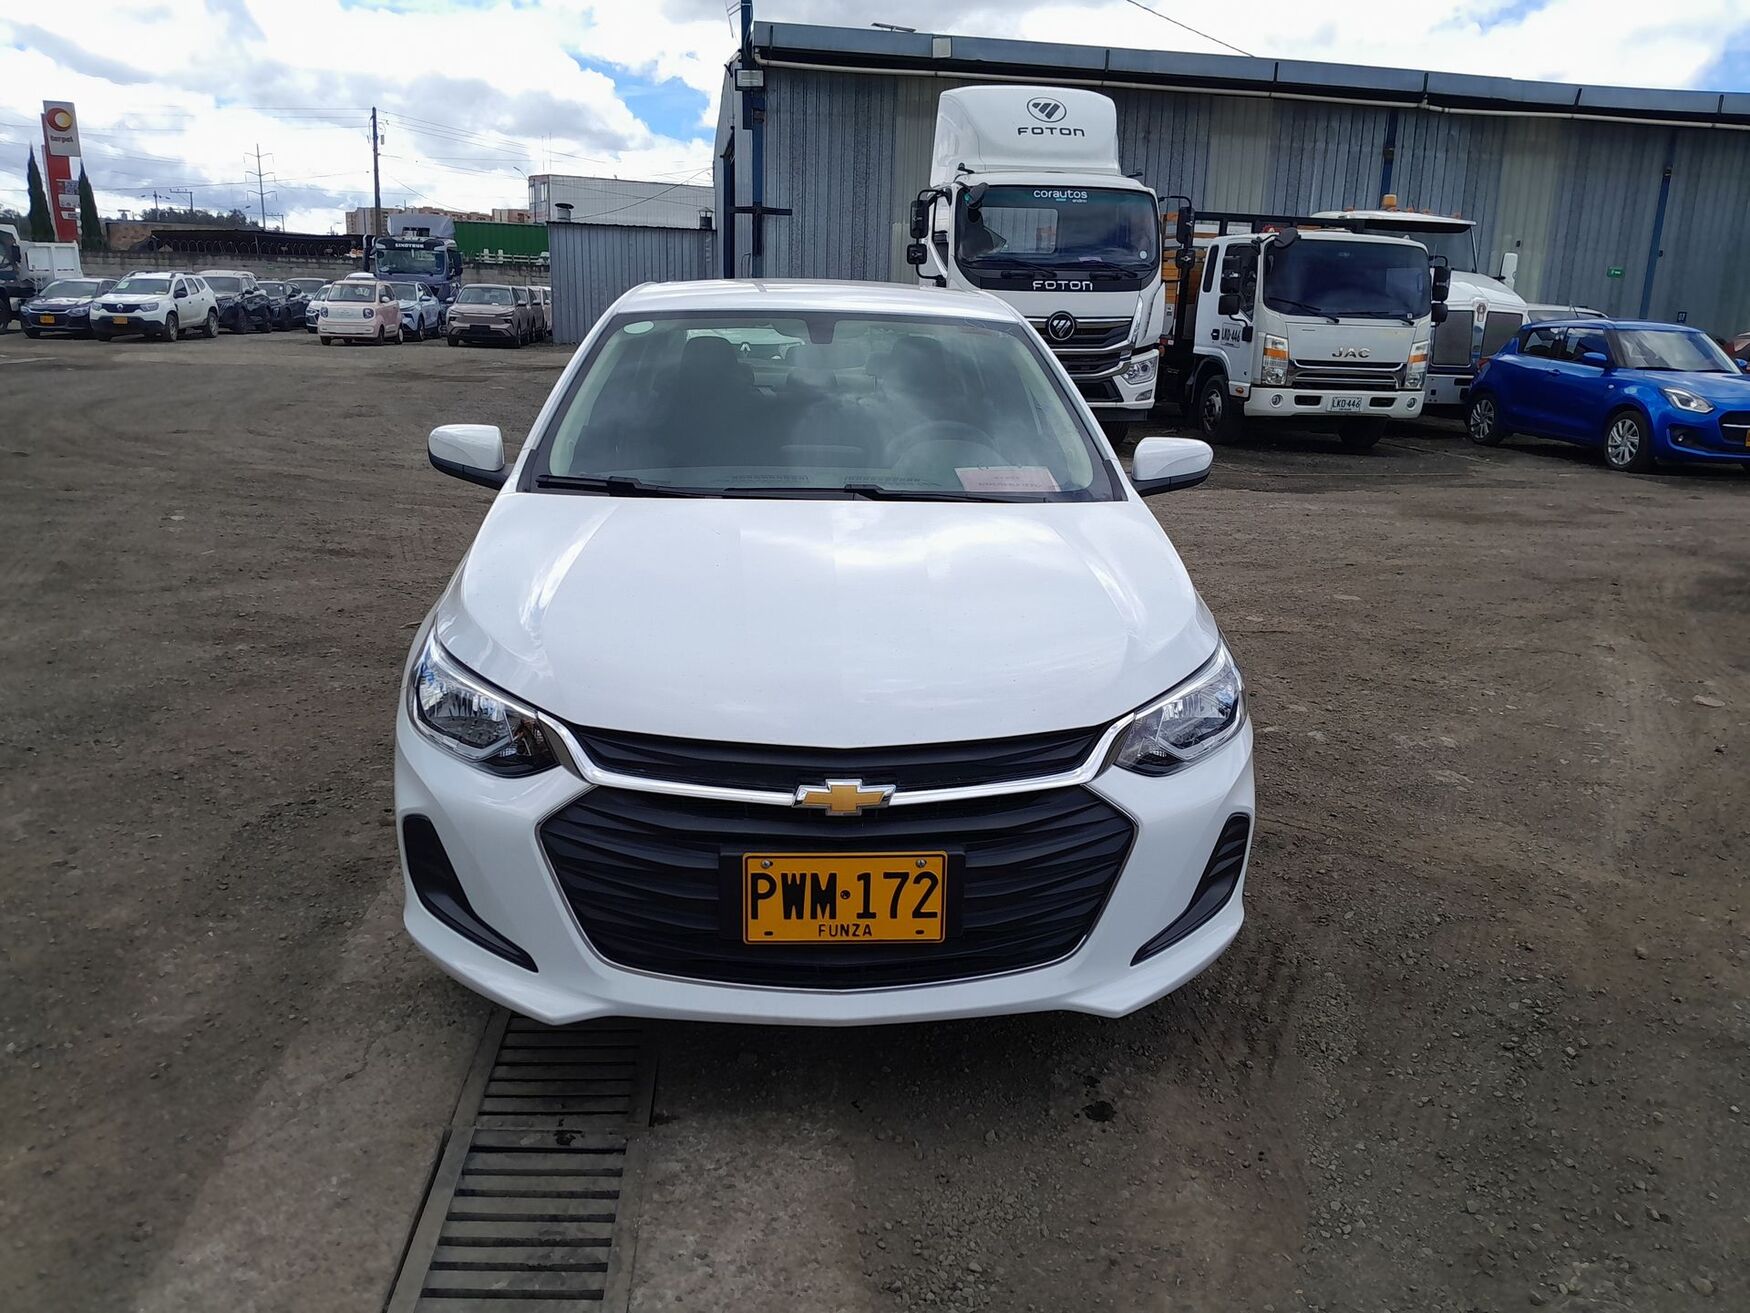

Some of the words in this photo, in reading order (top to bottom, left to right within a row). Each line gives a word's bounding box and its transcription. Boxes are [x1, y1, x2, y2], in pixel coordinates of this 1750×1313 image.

[1017, 126, 1085, 137] FOTON
[1033, 189, 1088, 199] corautos
[1032, 280, 1093, 291] FOTON
[1331, 347, 1371, 359] JAC
[818, 923, 873, 937] FUNZA
